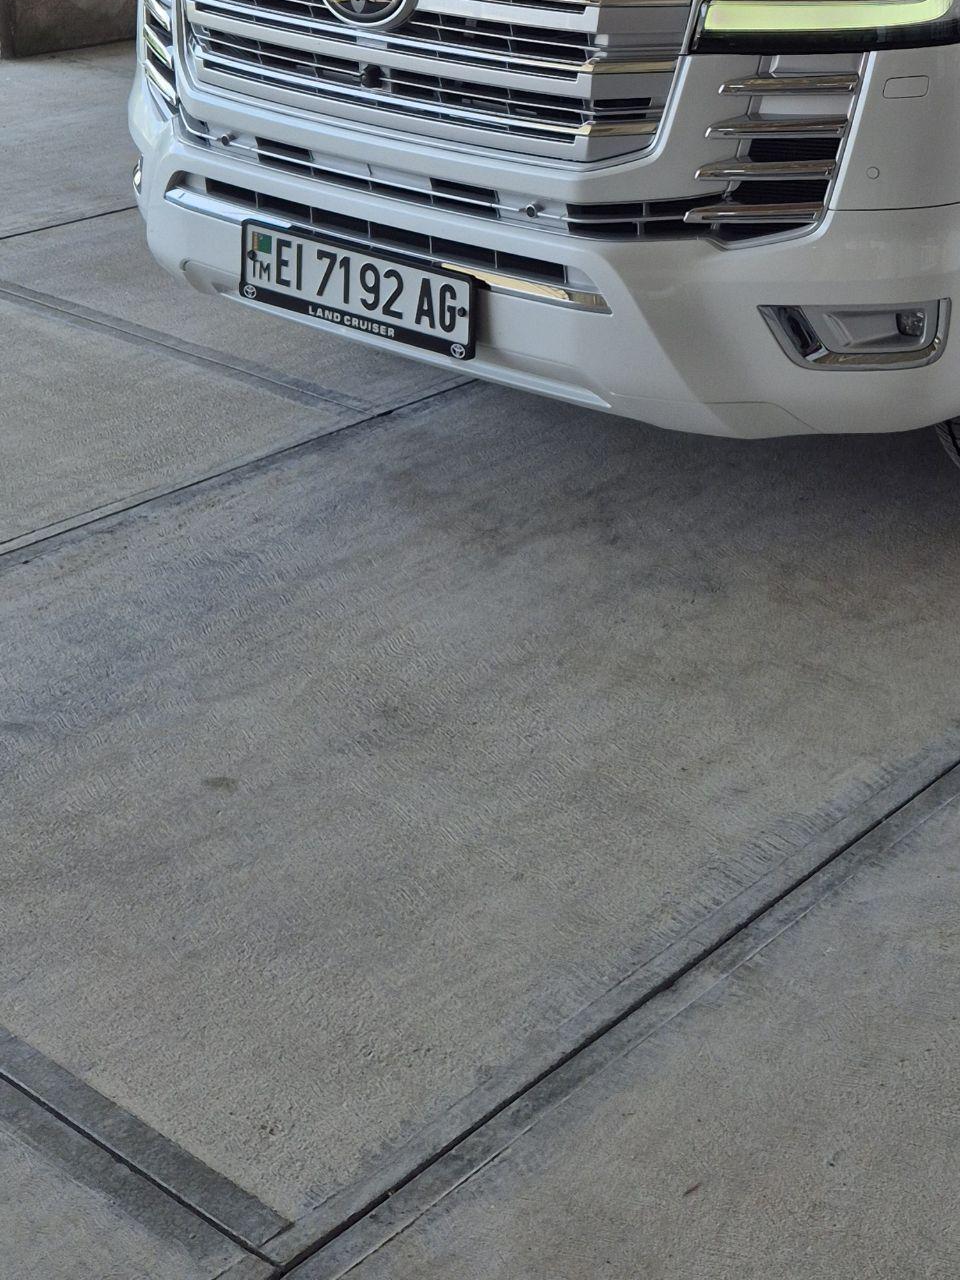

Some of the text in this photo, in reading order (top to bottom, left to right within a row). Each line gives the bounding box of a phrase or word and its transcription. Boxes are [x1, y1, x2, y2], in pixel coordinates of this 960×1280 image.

[252, 259, 271, 283] TM
[276, 238, 457, 333] EI 7192 AG
[308, 304, 395, 338] LAND CRUISER
